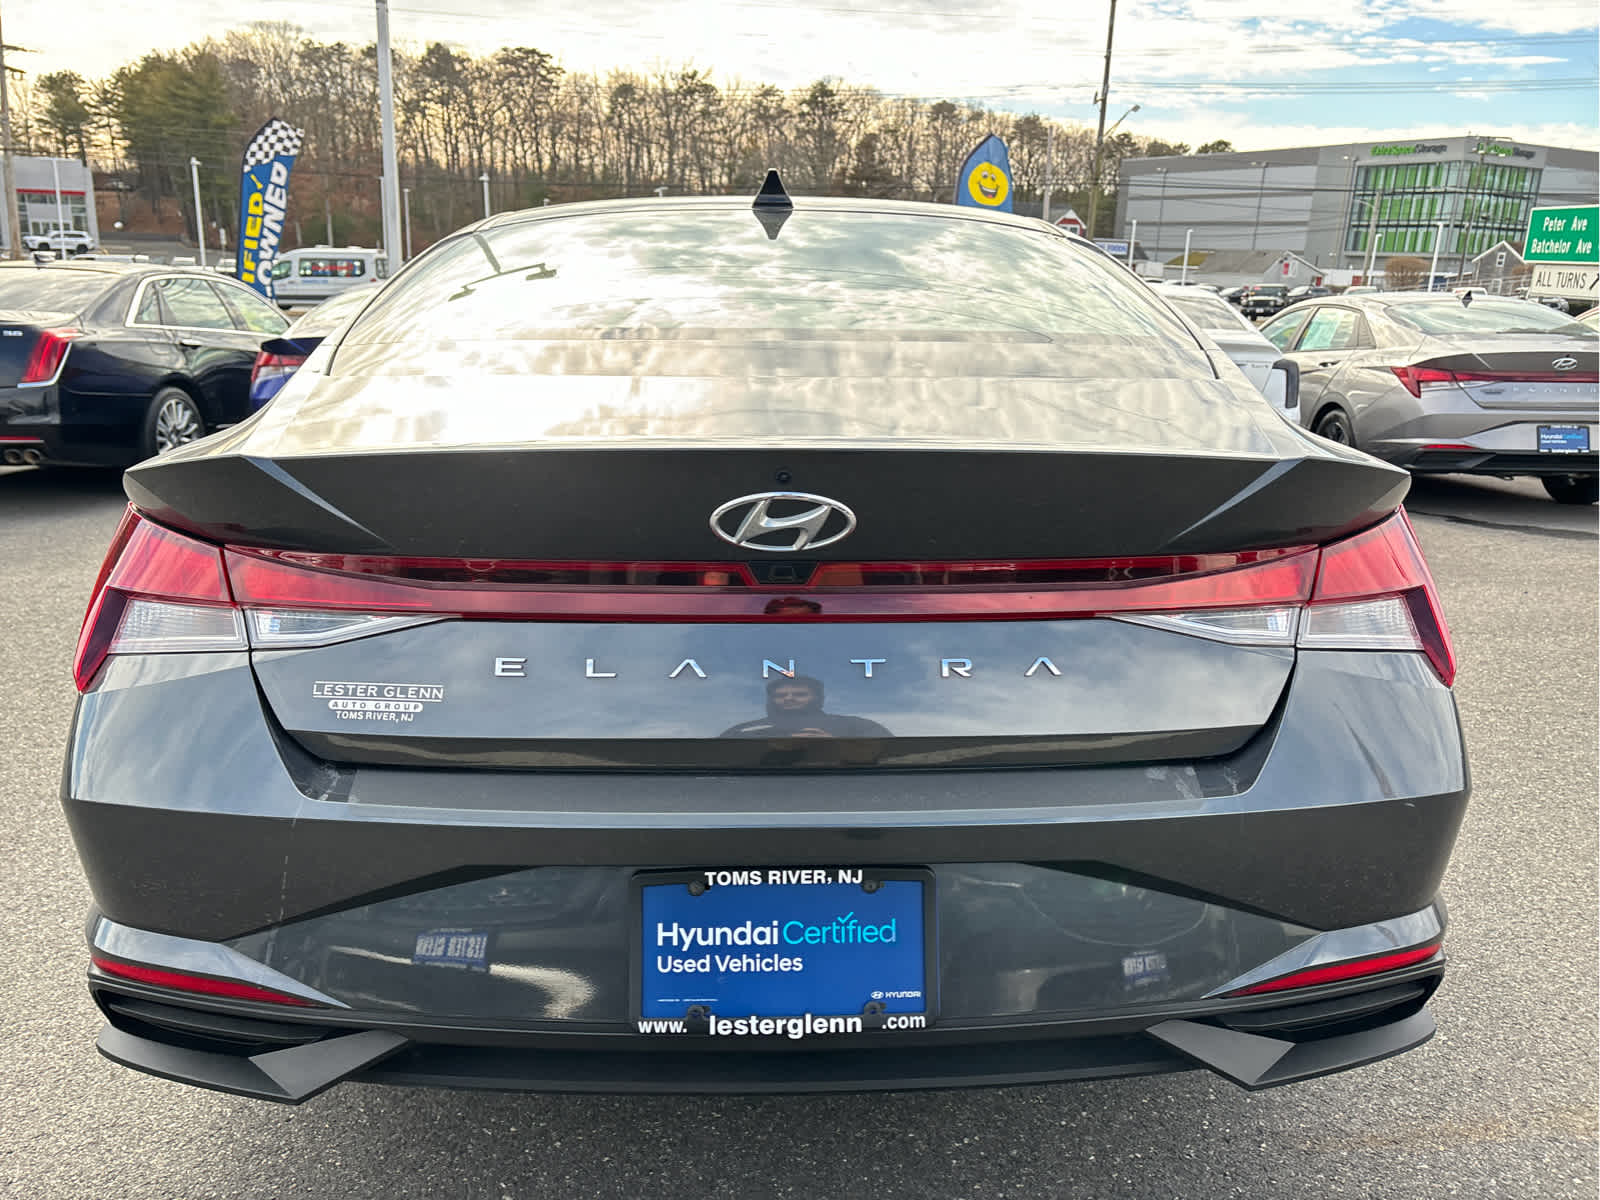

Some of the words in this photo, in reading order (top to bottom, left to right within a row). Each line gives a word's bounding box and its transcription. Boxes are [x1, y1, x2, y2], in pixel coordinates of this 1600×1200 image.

[1543, 216, 1567, 231] Peter
[1571, 215, 1588, 231] Ave
[1531, 238, 1571, 253] Batchelor
[1576, 238, 1592, 254] Ave
[1535, 271, 1552, 287] ALL
[1556, 271, 1587, 288] TURNS
[494, 656, 1062, 679] ELANTRA
[313, 684, 378, 697] LESTER
[383, 686, 444, 699] GLENN
[332, 701, 367, 709] AUTO
[374, 703, 420, 711] GROUP
[335, 710, 363, 720] TOMS
[365, 711, 399, 723] RIVER,
[400, 713, 414, 722] NJ
[704, 870, 762, 886] TOMS
[768, 869, 833, 885] RIVER,
[838, 869, 864, 884] NJ
[656, 920, 779, 951] Hyundai
[782, 914, 897, 945] Certified
[656, 955, 711, 973] Used
[714, 953, 804, 973] Vehicles
[884, 991, 922, 999] HYUNDAI
[638, 1020, 688, 1034] www.
[709, 1013, 862, 1039] lesterglenn
[881, 1015, 926, 1030] .com
